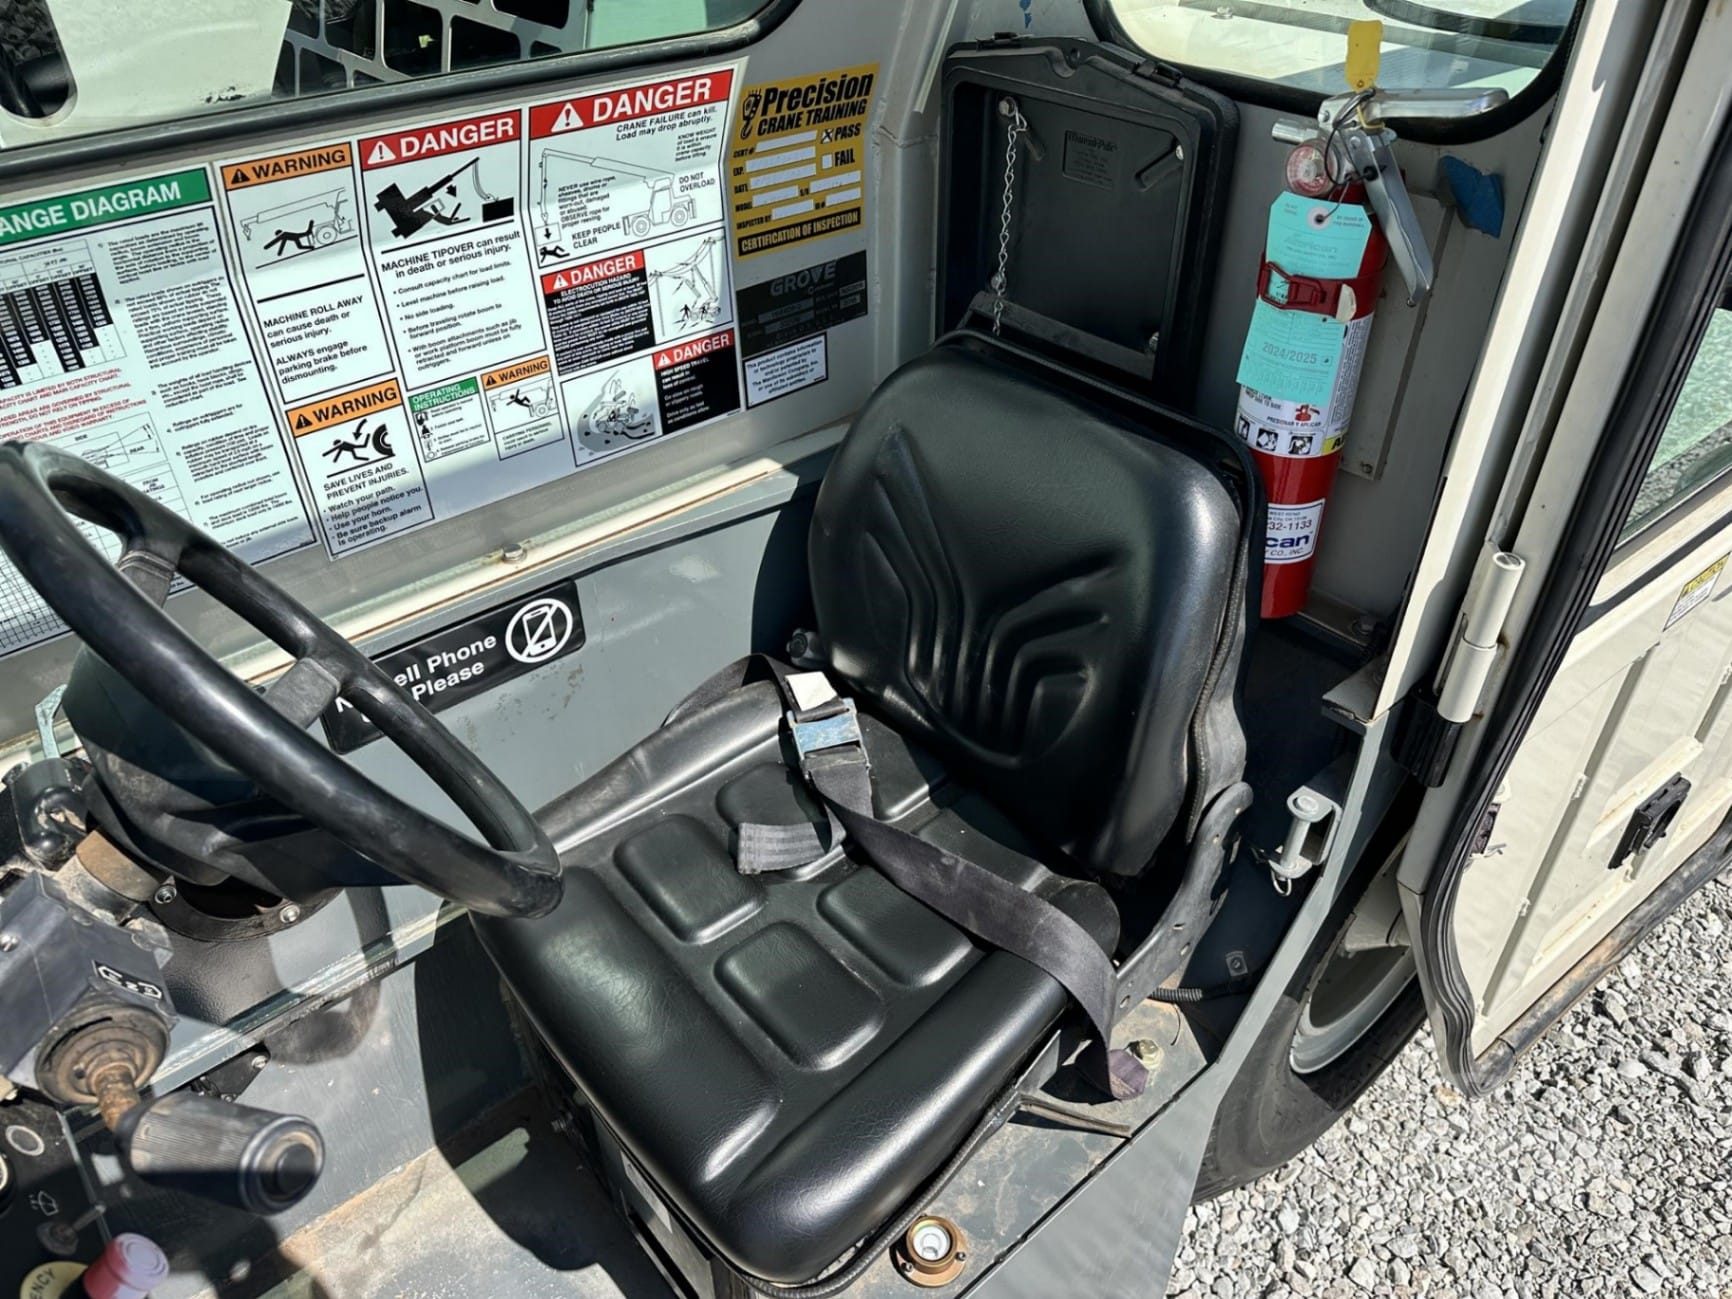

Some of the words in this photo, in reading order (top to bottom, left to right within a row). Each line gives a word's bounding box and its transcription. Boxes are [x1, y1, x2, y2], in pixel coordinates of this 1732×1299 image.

[593, 78, 711, 121] DANGER
[761, 74, 873, 116] Precision
[615, 129, 637, 141] Load
[638, 127, 656, 136] may
[657, 122, 677, 132] drop
[678, 115, 711, 128] abruptly.
[616, 119, 647, 132] CRANE
[649, 112, 685, 126] FAILURE
[687, 110, 701, 118] can
[703, 106, 716, 114] kill.
[757, 111, 803, 136] CRANE
[806, 99, 867, 125] TRAINING
[834, 122, 861, 140] PASS
[400, 118, 513, 157] DANGER
[252, 149, 345, 178] WARNING
[834, 148, 855, 167] FAIL
[679, 175, 689, 184] DO
[690, 171, 703, 180] NOT
[679, 178, 715, 192] OVERLOAD
[0, 205, 66, 236] ANGE
[71, 182, 180, 219] DIAGRAM
[571, 229, 591, 240] KEEP
[592, 222, 620, 234] PEOPLE
[573, 236, 598, 249] CLEAR
[741, 227, 801, 251] CERTIFICATION
[802, 223, 811, 235] OF
[813, 211, 858, 232] INSPECTION
[381, 252, 429, 272] MACHINE
[431, 241, 474, 259] TIPOVER
[476, 238, 493, 248] can
[494, 230, 520, 243] result
[395, 270, 405, 278] in
[407, 262, 434, 275] death
[436, 259, 446, 268] or
[448, 250, 482, 264] serious
[484, 244, 511, 255] injury.
[570, 255, 635, 284] DANGER
[770, 262, 838, 298] GROVE
[263, 310, 308, 328] MACHINE
[309, 303, 335, 316] ROLL
[337, 295, 362, 309] AWAY
[266, 329, 284, 338] can
[285, 321, 312, 333] cause
[314, 314, 339, 326] death
[340, 311, 350, 319] or
[270, 334, 303, 348] serious
[304, 327, 331, 338] injury.
[672, 334, 728, 362] DANGER
[276, 348, 315, 365] ALWAYS
[316, 341, 348, 354] engage
[278, 360, 312, 376] parking
[313, 353, 338, 365] brake
[339, 345, 367, 357] before
[1261, 341, 1318, 365] 2024/2025
[281, 364, 337, 384] dismounting.
[498, 360, 547, 381] WARNING
[313, 387, 397, 422] WARNING
[412, 383, 460, 403] OPERATING
[414, 386, 475, 410] INSTRUCTIONS
[323, 478, 346, 491] SAVE
[348, 469, 373, 483] LIVES
[375, 462, 393, 474] AND
[326, 481, 366, 499] PREVENT
[368, 467, 407, 485] INJURIES.
[328, 500, 354, 512] Watch
[355, 493, 373, 505] your
[375, 486, 396, 498] path.
[330, 511, 350, 521] Help
[351, 501, 379, 515] people
[380, 492, 405, 504] notice
[405, 486, 421, 496] you.
[333, 520, 350, 530] Use
[351, 513, 370, 525] your
[371, 506, 392, 517] horn.
[336, 531, 348, 539] Be
[349, 524, 368, 534] sure
[368, 513, 398, 527] backup
[399, 505, 421, 516] alarm
[1268, 519, 1313, 531] 32-1133
[1266, 534, 1310, 548] can
[394, 663, 421, 687] ell
[427, 636, 496, 673] Phone
[411, 662, 484, 700] Please
[29, 1267, 56, 1299] ENCY
